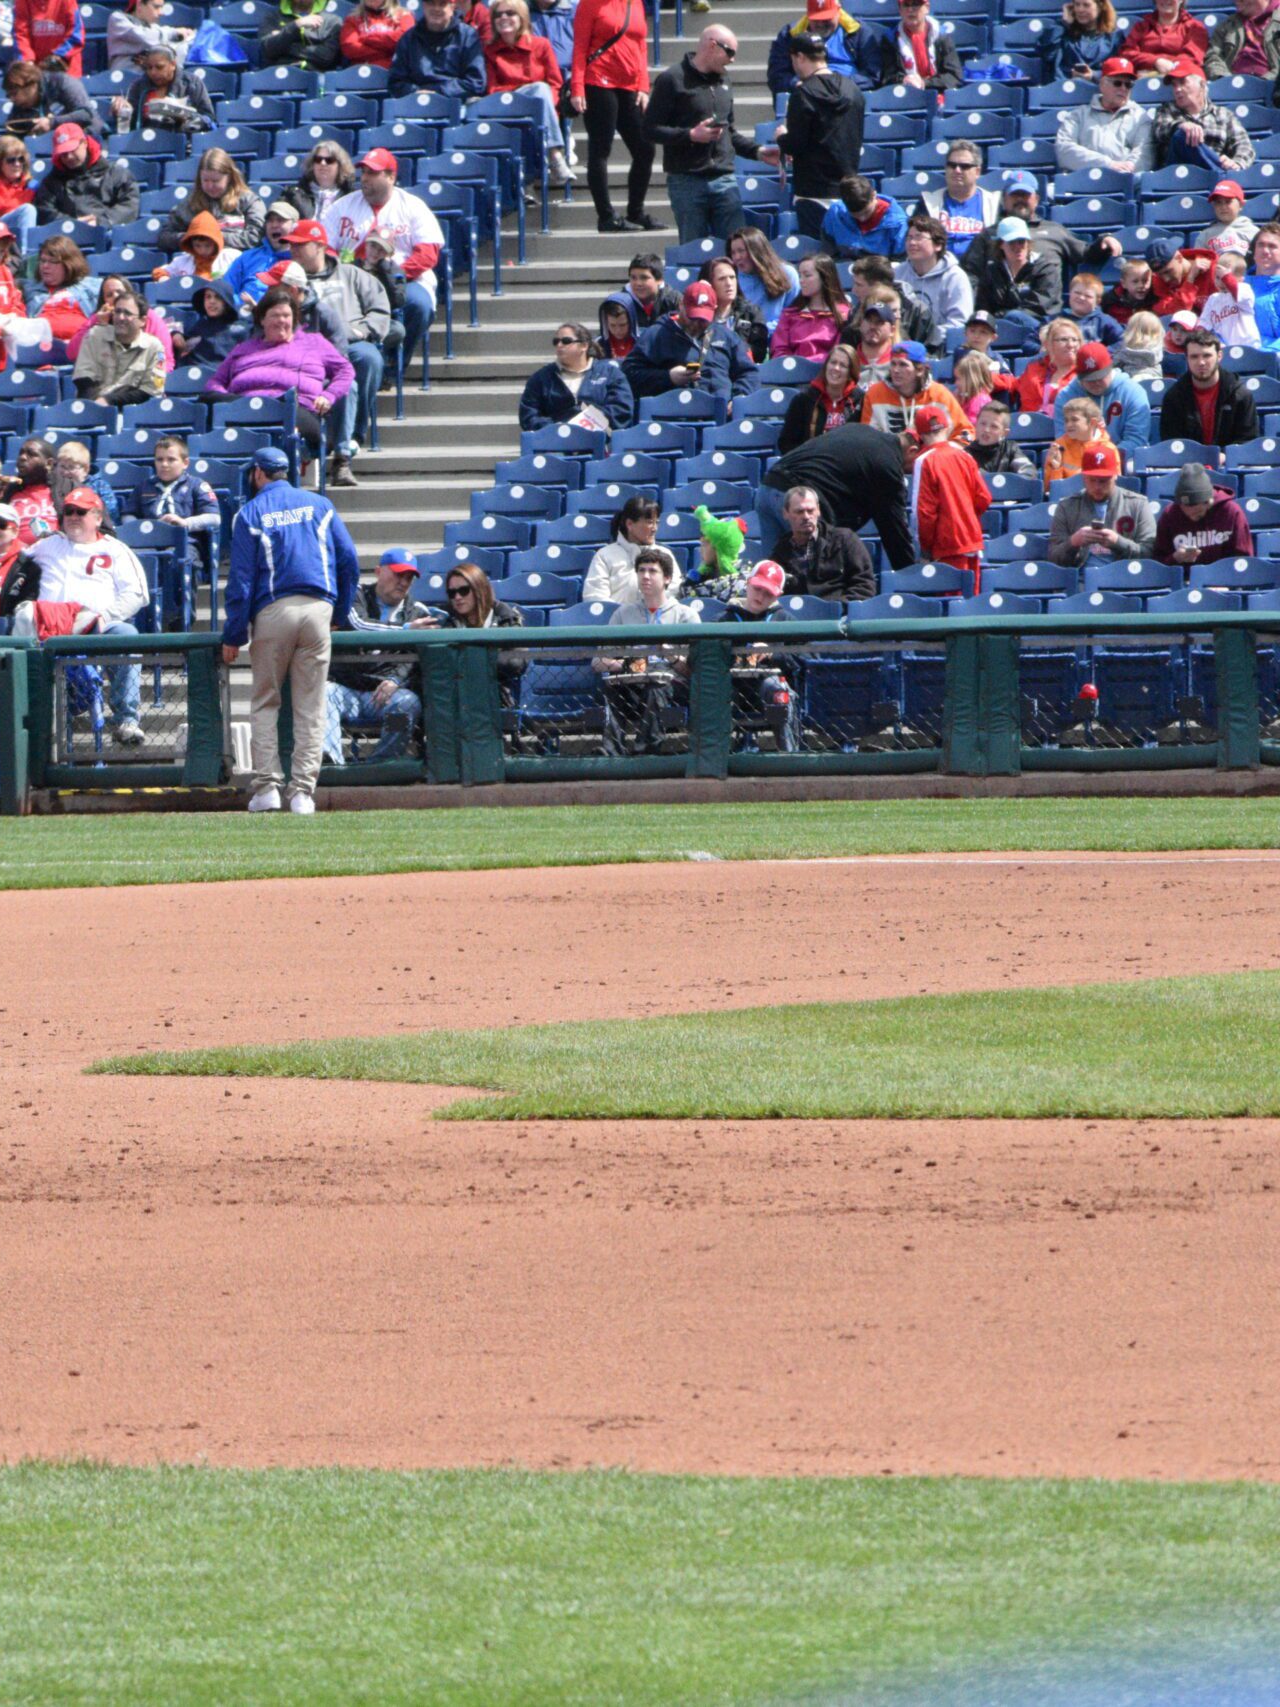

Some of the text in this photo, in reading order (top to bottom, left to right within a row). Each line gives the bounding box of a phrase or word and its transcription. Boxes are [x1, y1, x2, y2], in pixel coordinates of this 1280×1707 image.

[1095, 452, 1105, 465] P
[261, 505, 314, 528] STAFF
[85, 554, 112, 575] P
